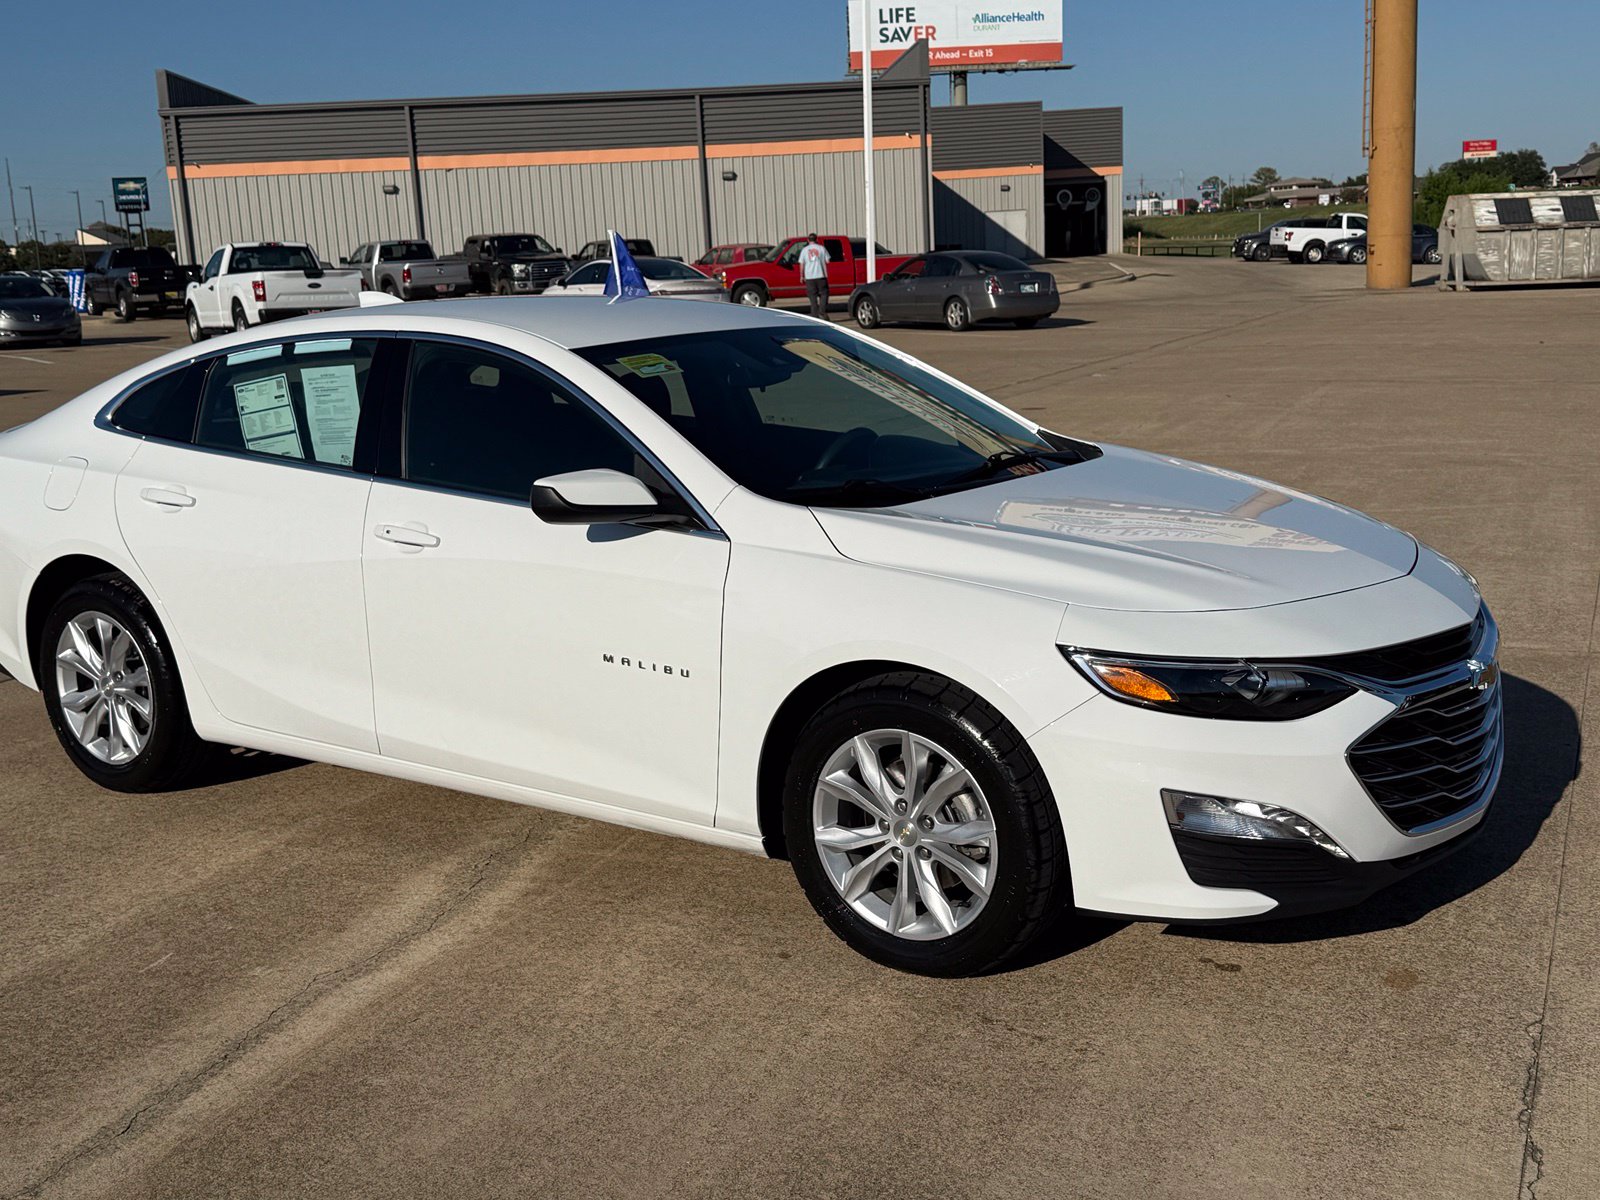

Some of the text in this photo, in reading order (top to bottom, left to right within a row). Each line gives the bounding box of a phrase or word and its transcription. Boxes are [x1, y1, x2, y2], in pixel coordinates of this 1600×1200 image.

[879, 7, 916, 24] LIFE
[973, 11, 1045, 23] AllianceHealth
[879, 25, 937, 43] SAVER
[935, 50, 960, 59] Ahead
[968, 49, 984, 58] Exit
[985, 48, 994, 57] 15
[602, 653, 690, 678] MALIBU
